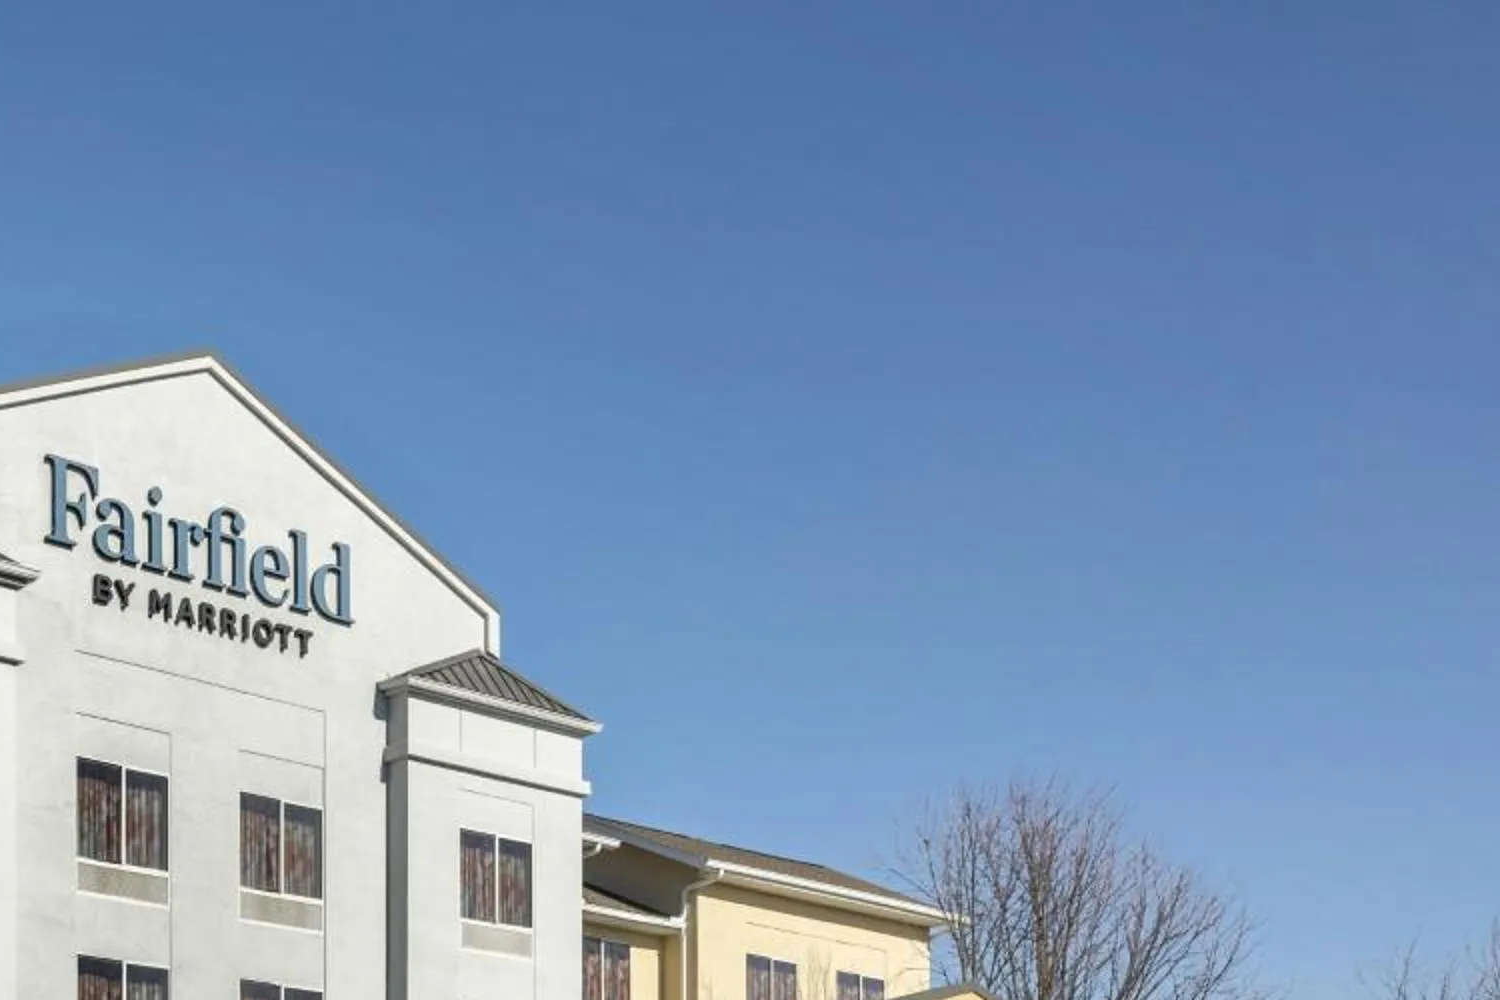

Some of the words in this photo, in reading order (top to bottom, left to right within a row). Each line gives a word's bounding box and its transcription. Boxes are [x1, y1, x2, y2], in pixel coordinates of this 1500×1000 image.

[44, 453, 355, 627] Fairfield
[92, 574, 135, 611] BY
[148, 589, 313, 658] MARRIOTT
